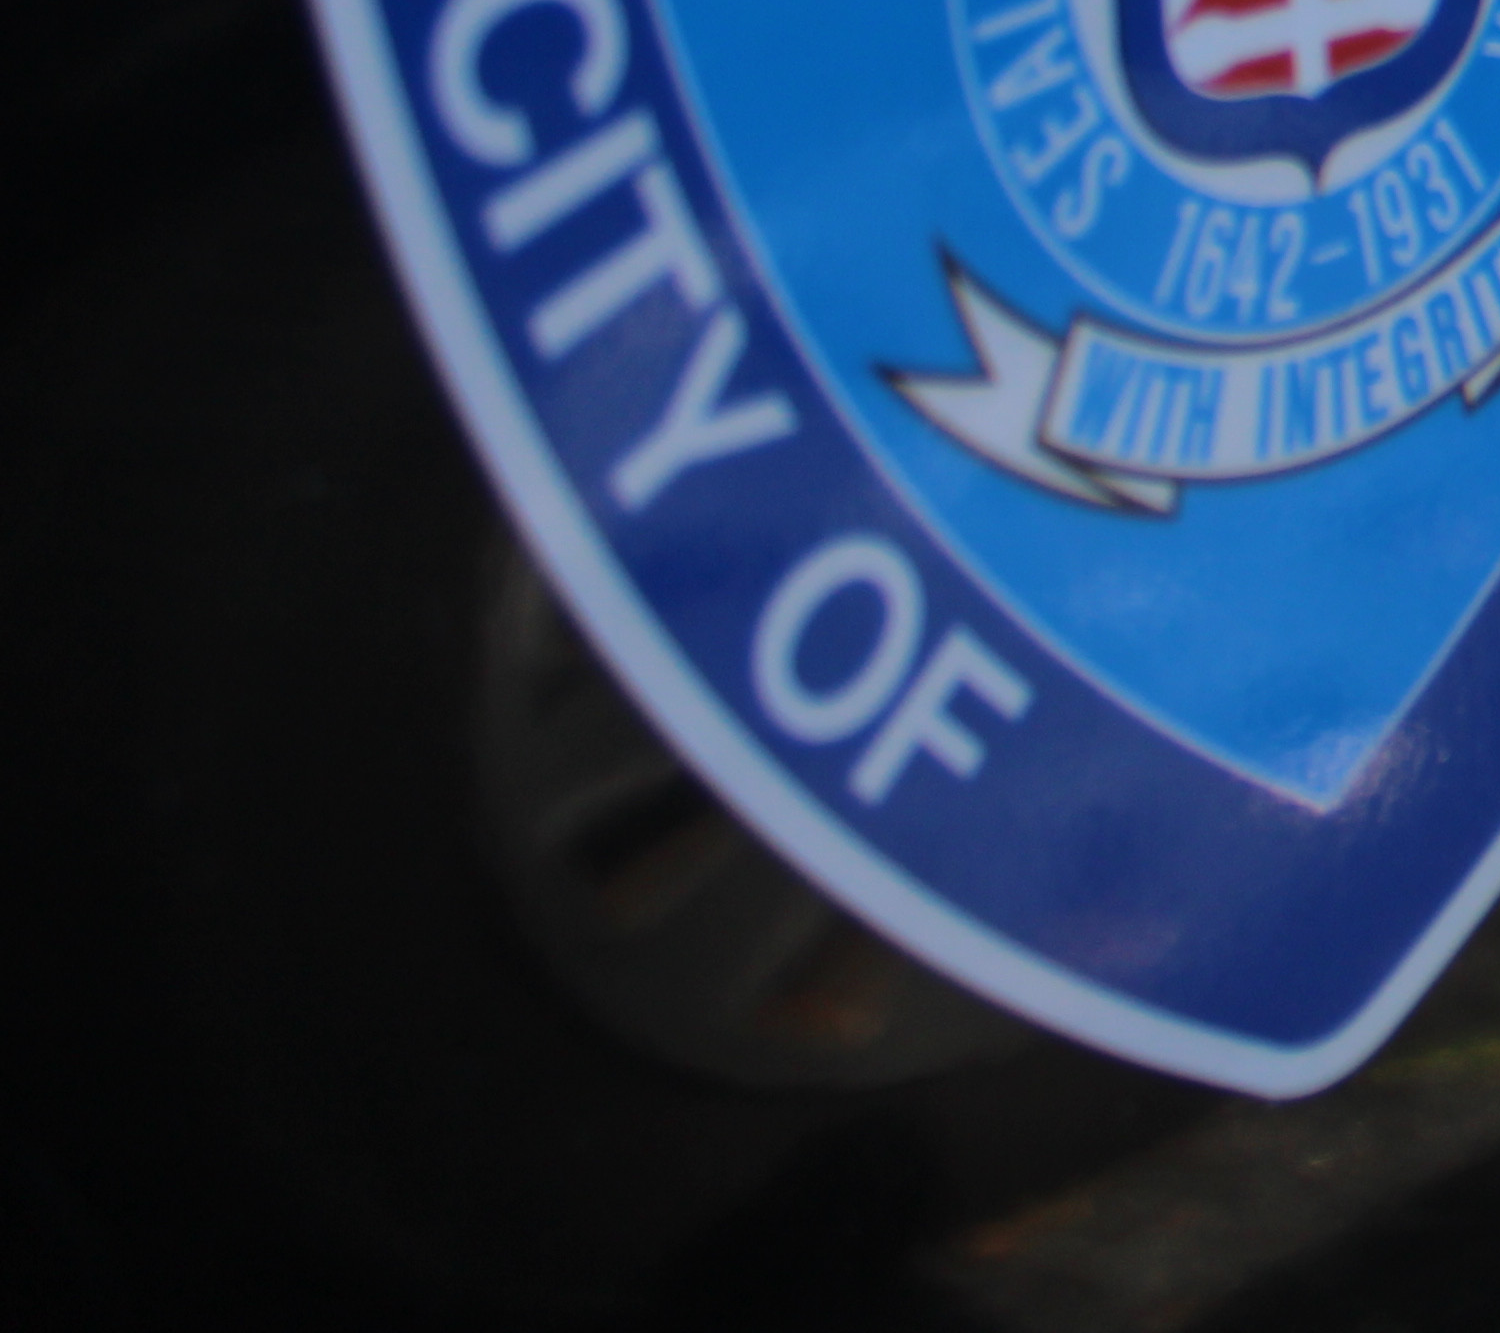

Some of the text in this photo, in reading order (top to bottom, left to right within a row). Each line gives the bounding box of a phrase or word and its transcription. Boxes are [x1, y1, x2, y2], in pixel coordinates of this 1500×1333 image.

[1155, 117, 1487, 324] 1642-1931
[1067, 348, 1229, 464] WITH
[748, 533, 1033, 808] OF
